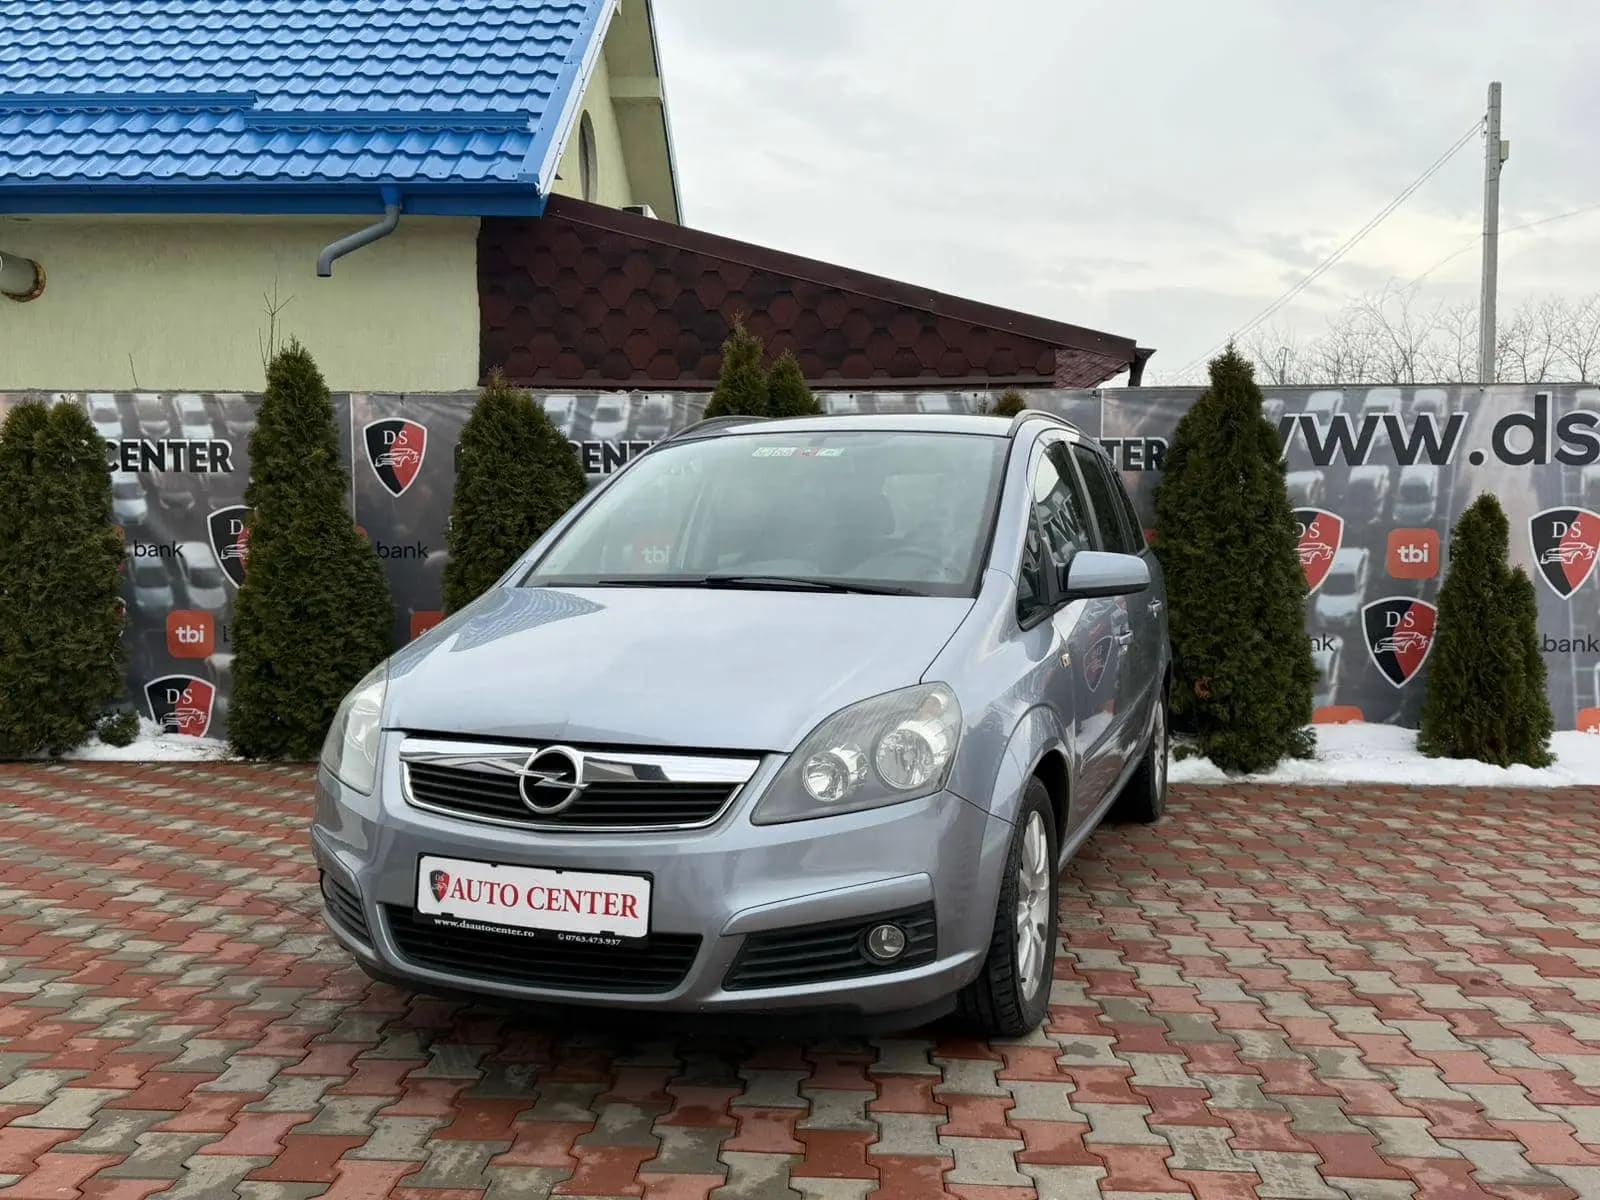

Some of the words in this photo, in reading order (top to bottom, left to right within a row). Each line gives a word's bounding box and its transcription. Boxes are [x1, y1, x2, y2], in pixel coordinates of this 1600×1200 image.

[1278, 390, 1600, 466] ww.ds
[383, 430, 409, 446] DS
[1552, 521, 1582, 538] DS
[133, 540, 185, 558] bank
[376, 540, 429, 559] bank
[1397, 543, 1430, 564] tbi
[1385, 611, 1416, 628] DS
[175, 624, 205, 644] tbi
[1543, 633, 1600, 653] bank
[166, 688, 193, 705] DS
[449, 877, 519, 908] AUTO
[526, 886, 640, 919] CENTER
[434, 918, 535, 938] www.dsautocenter.ro
